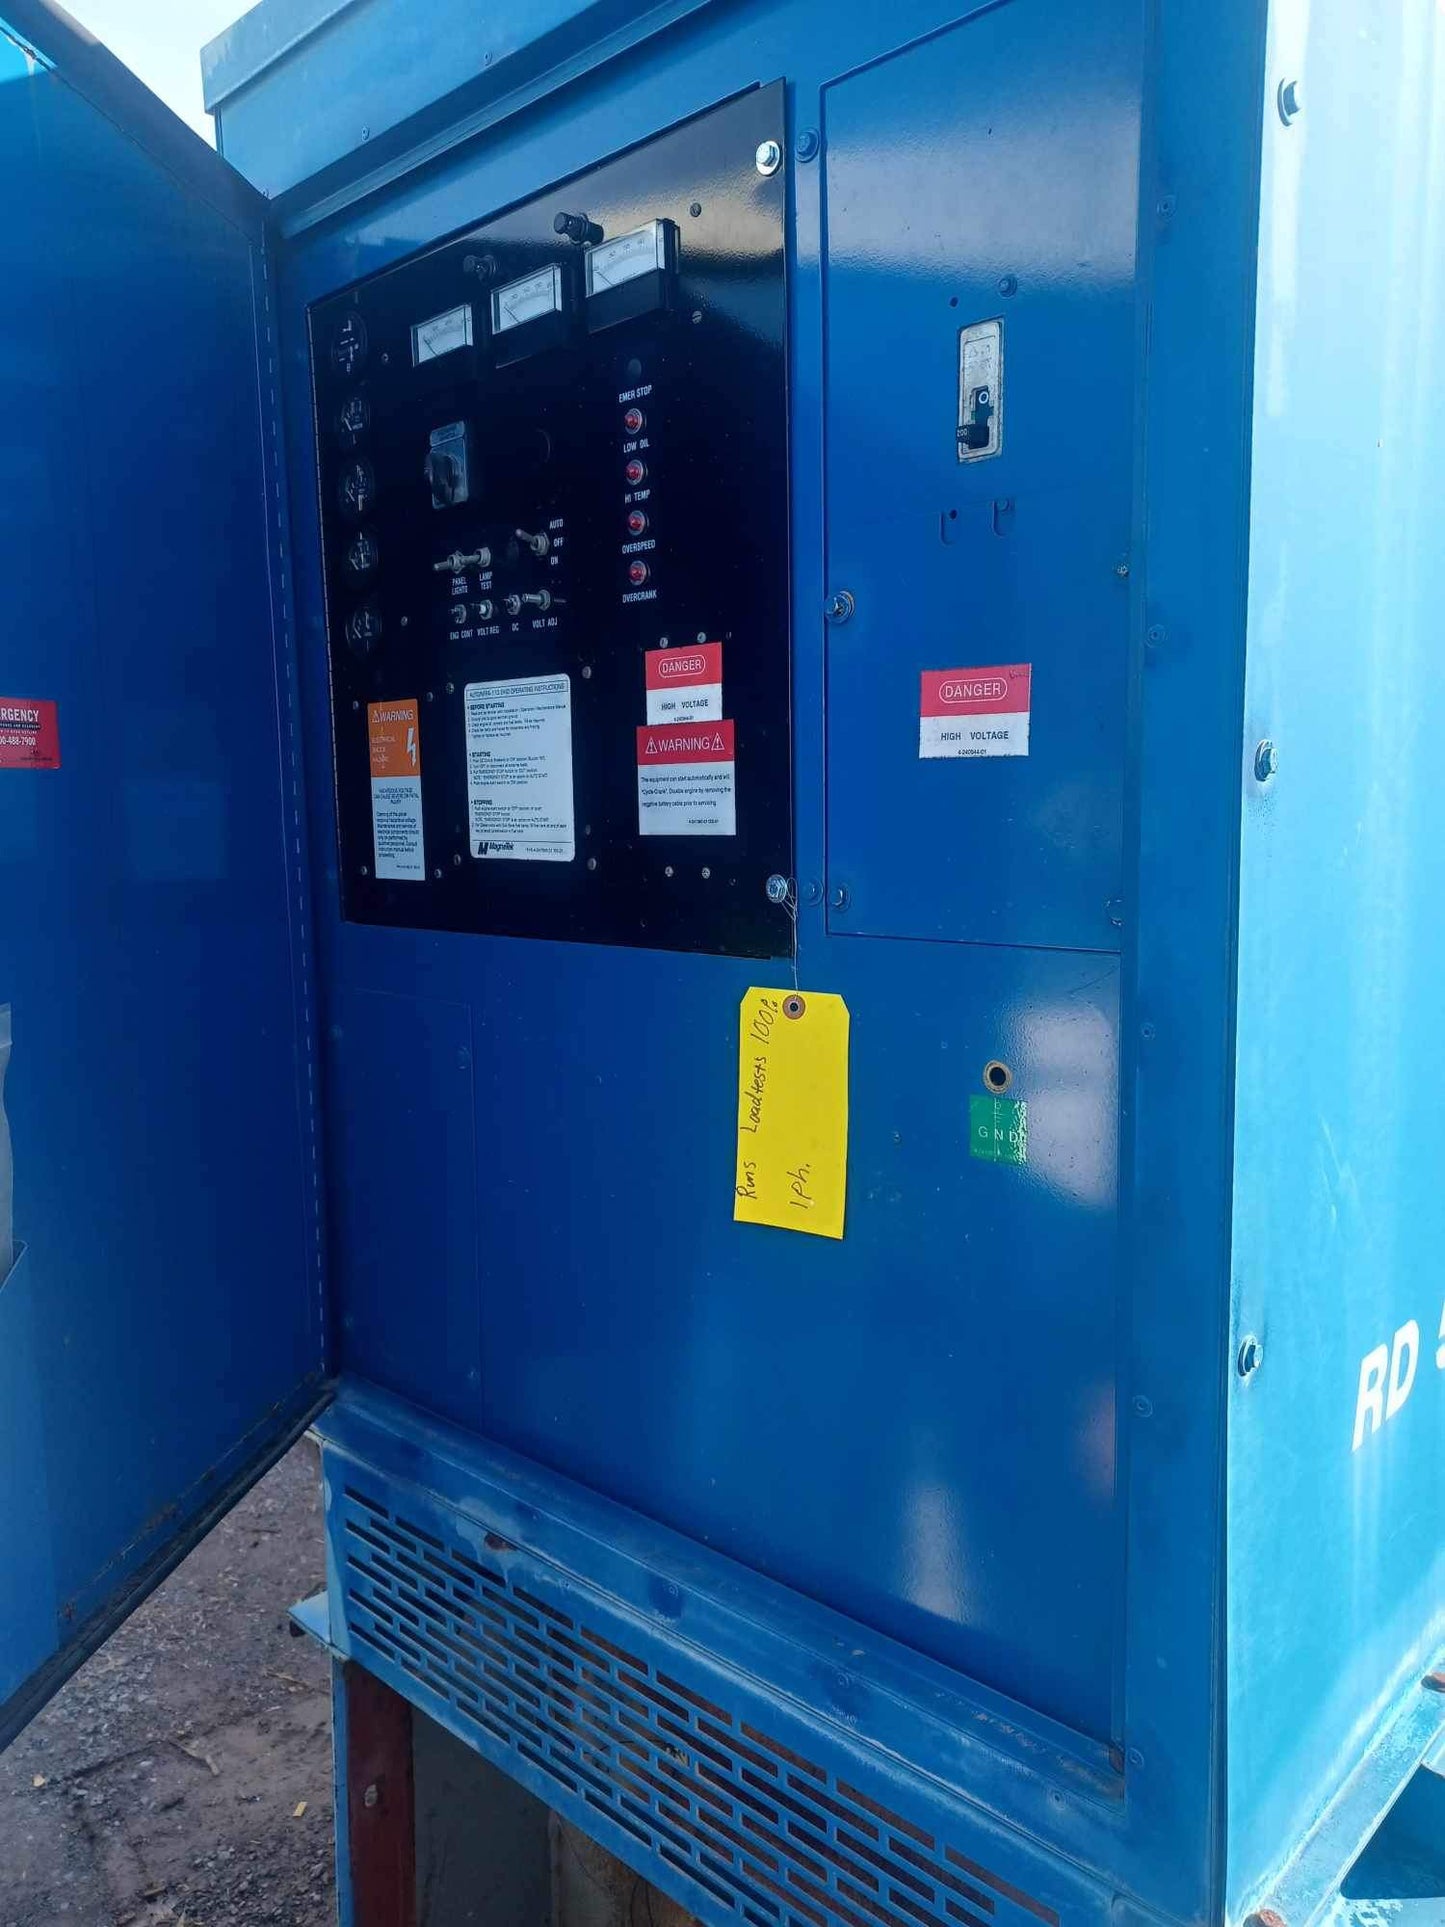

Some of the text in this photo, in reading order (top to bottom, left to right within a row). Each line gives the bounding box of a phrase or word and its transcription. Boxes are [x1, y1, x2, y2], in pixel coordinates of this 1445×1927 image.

[619, 384, 652, 403] EMER STOP
[623, 438, 649, 453] LOW OIL
[634, 489, 651, 501] TEMP
[549, 518, 564, 530] AUTO
[553, 537, 563, 547] OFF
[622, 539, 656, 554] OVERSPEED
[550, 556, 559, 566] ON
[480, 580, 492, 591] TEST
[622, 589, 657, 603] OVERCRANK
[532, 617, 558, 629] VOLT ADJ
[461, 629, 473, 639] CONT
[477, 627, 489, 637] VOLT
[661, 659, 702, 674] DANGER
[945, 682, 1001, 698] DANGER
[661, 698, 709, 711] HIGH VOLTAGE
[379, 709, 414, 723] WARNING
[940, 730, 1009, 741] HIGH VOLTAGE
[658, 736, 710, 752] WARNING
[1352, 1319, 1420, 1452] RD
